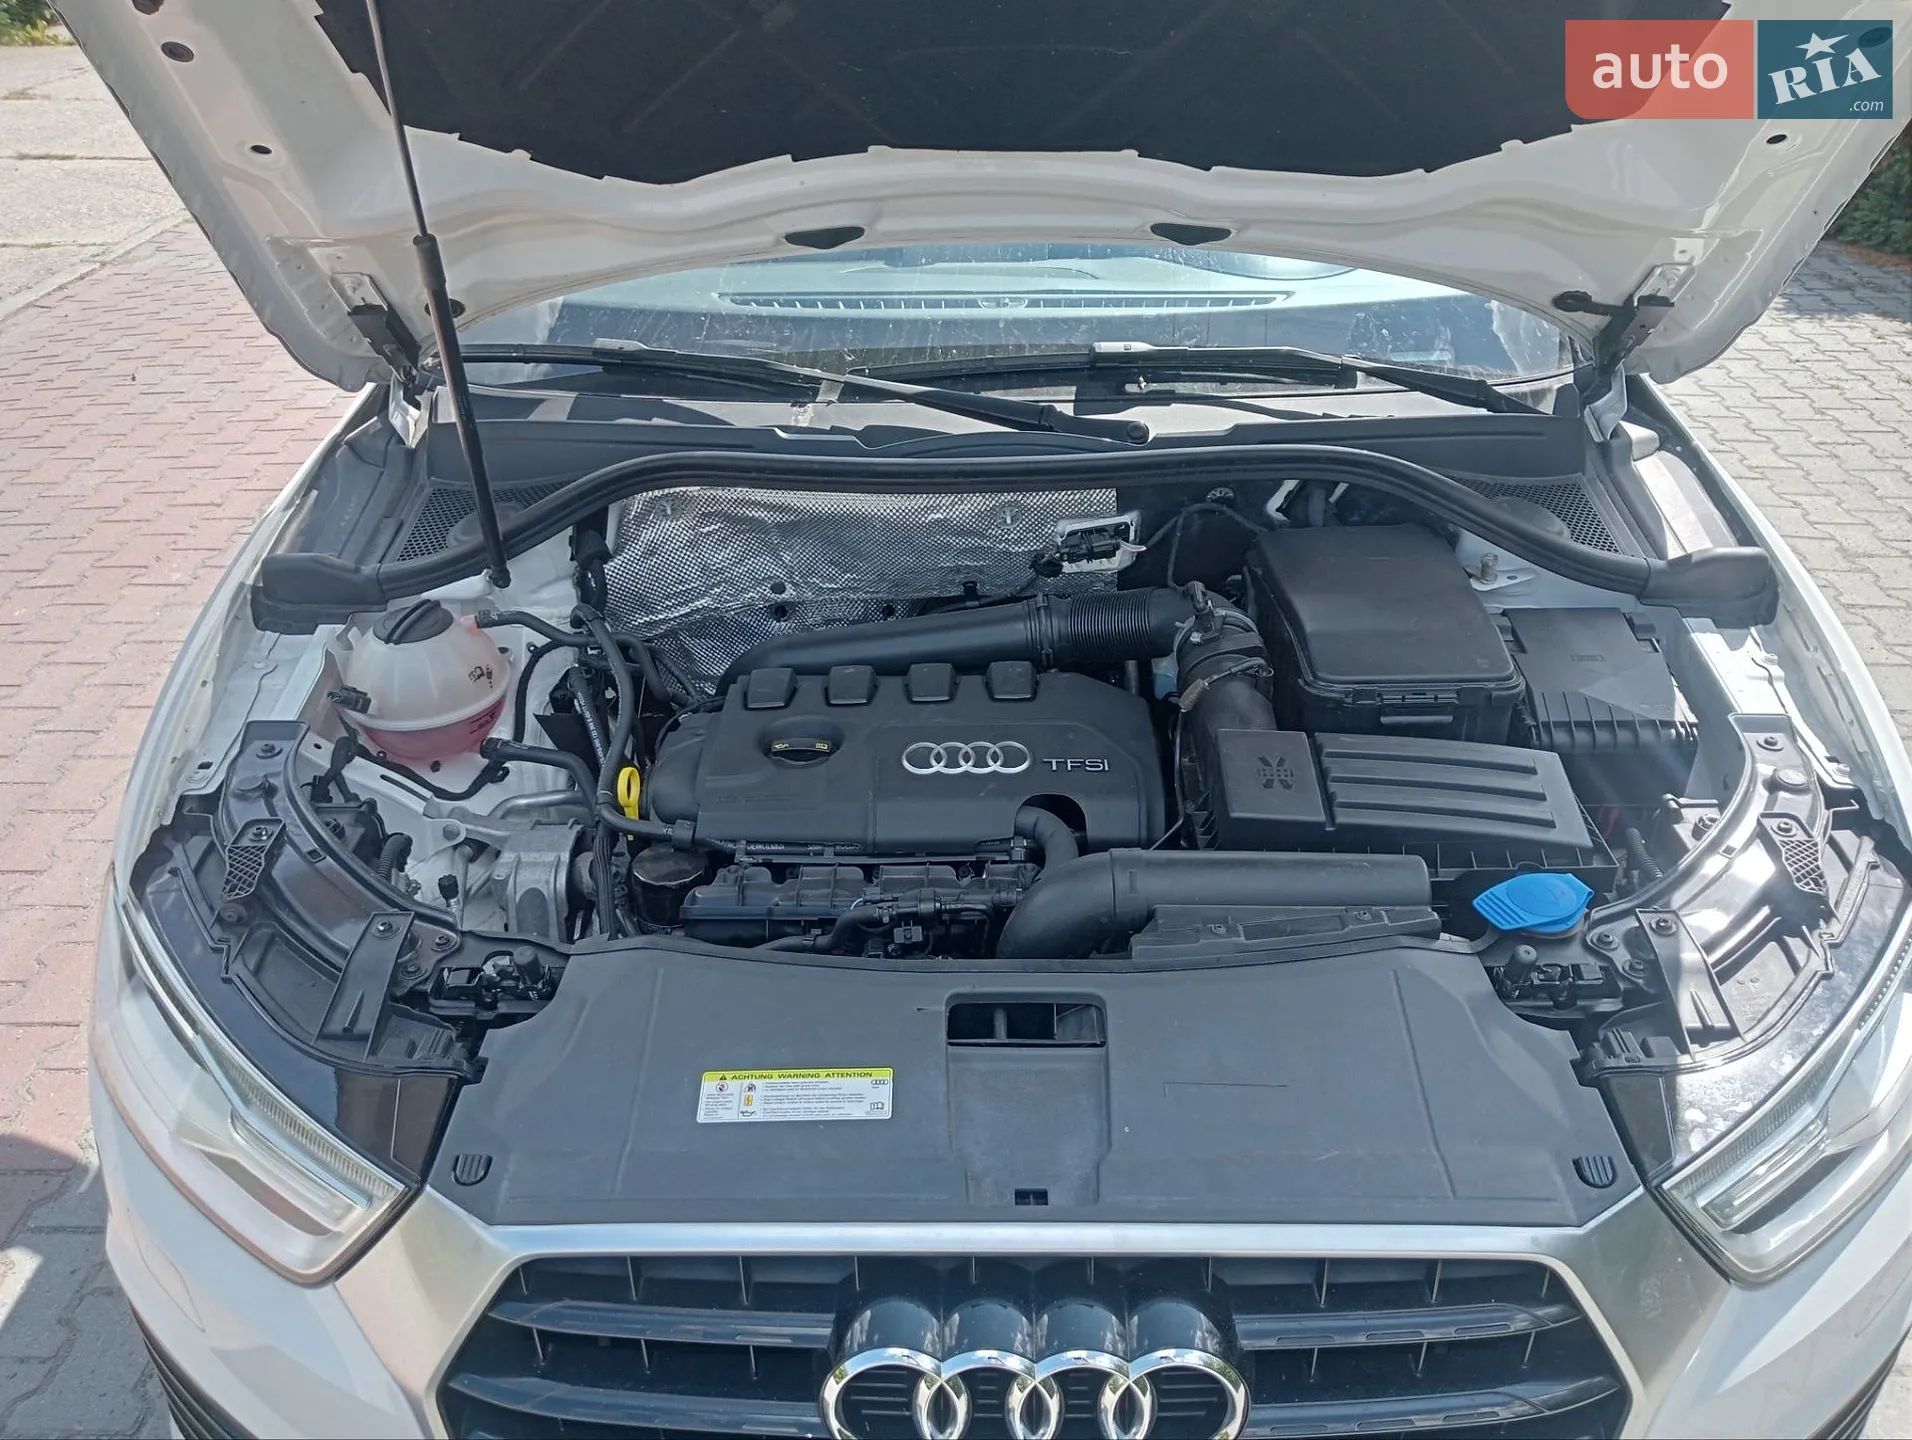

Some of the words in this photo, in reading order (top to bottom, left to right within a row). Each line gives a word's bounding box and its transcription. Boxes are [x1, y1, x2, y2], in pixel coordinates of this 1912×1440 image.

[1042, 758, 1109, 771] TFSI
[777, 1072, 821, 1080] WARNING
[825, 1071, 873, 1079] ATTENTION
